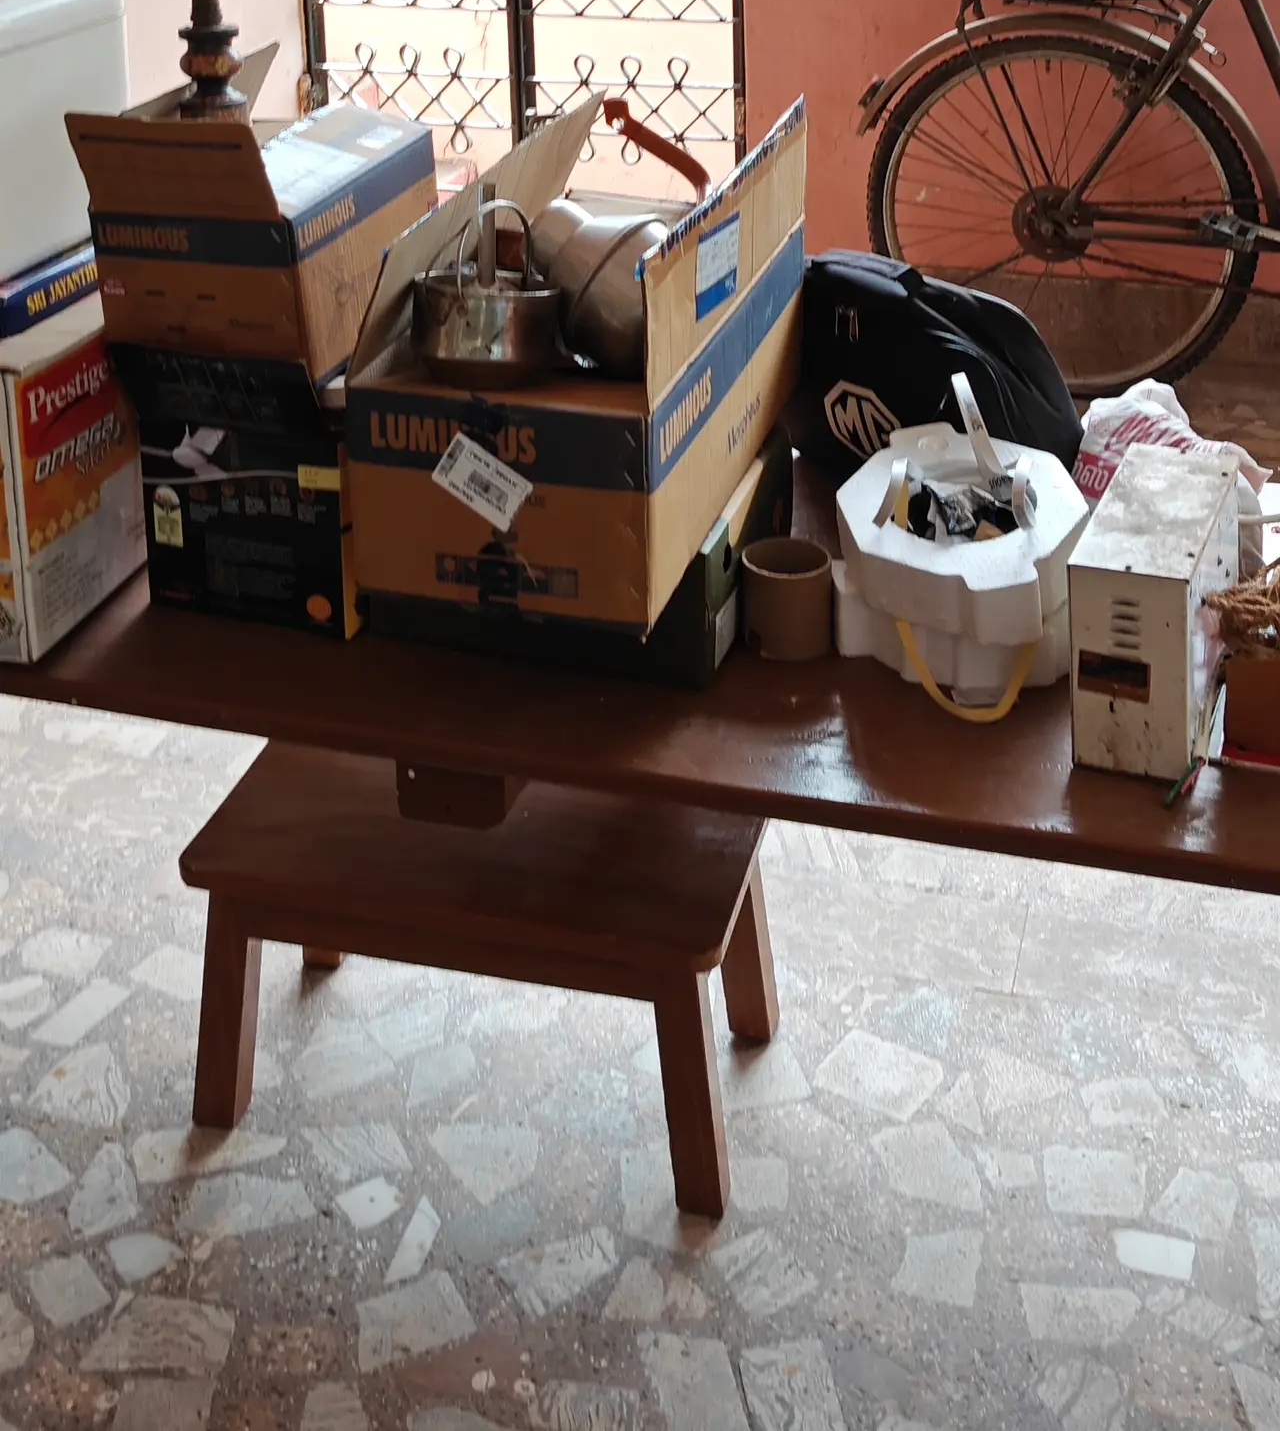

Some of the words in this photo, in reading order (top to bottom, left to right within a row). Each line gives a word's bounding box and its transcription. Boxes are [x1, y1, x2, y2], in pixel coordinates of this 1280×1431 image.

[97, 222, 189, 254] LUMINOUS
[297, 192, 356, 252] LUMINOUS
[26, 287, 47, 317] SRI
[26, 361, 110, 424] Prestige
[659, 365, 712, 465] LUMINOUS
[368, 410, 537, 466] LUMIUS
